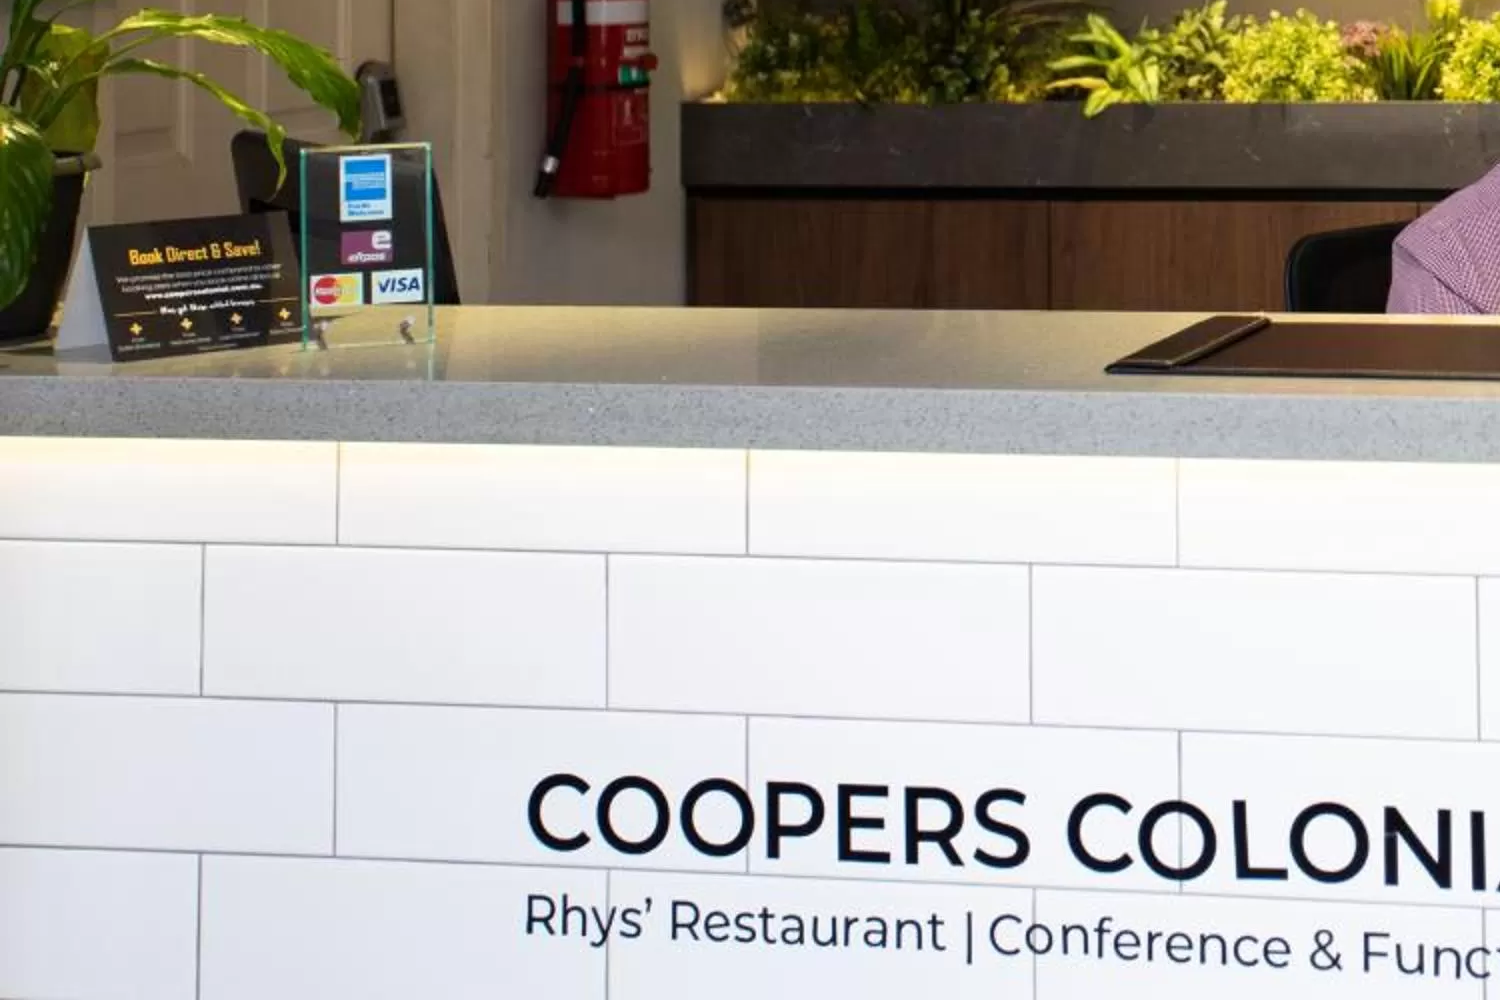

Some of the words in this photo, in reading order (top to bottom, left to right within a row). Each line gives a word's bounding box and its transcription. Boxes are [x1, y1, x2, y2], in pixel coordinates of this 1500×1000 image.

[128, 247, 164, 266] Book
[165, 245, 209, 263] Direct
[211, 243, 221, 259] &
[223, 239, 261, 257] Save!
[378, 277, 421, 293] VISA
[527, 773, 1032, 870] COOPERS
[524, 893, 653, 948] Rhys’
[668, 900, 947, 952] Restaurant
[987, 912, 1293, 968] Conference
[1308, 928, 1344, 972] &
